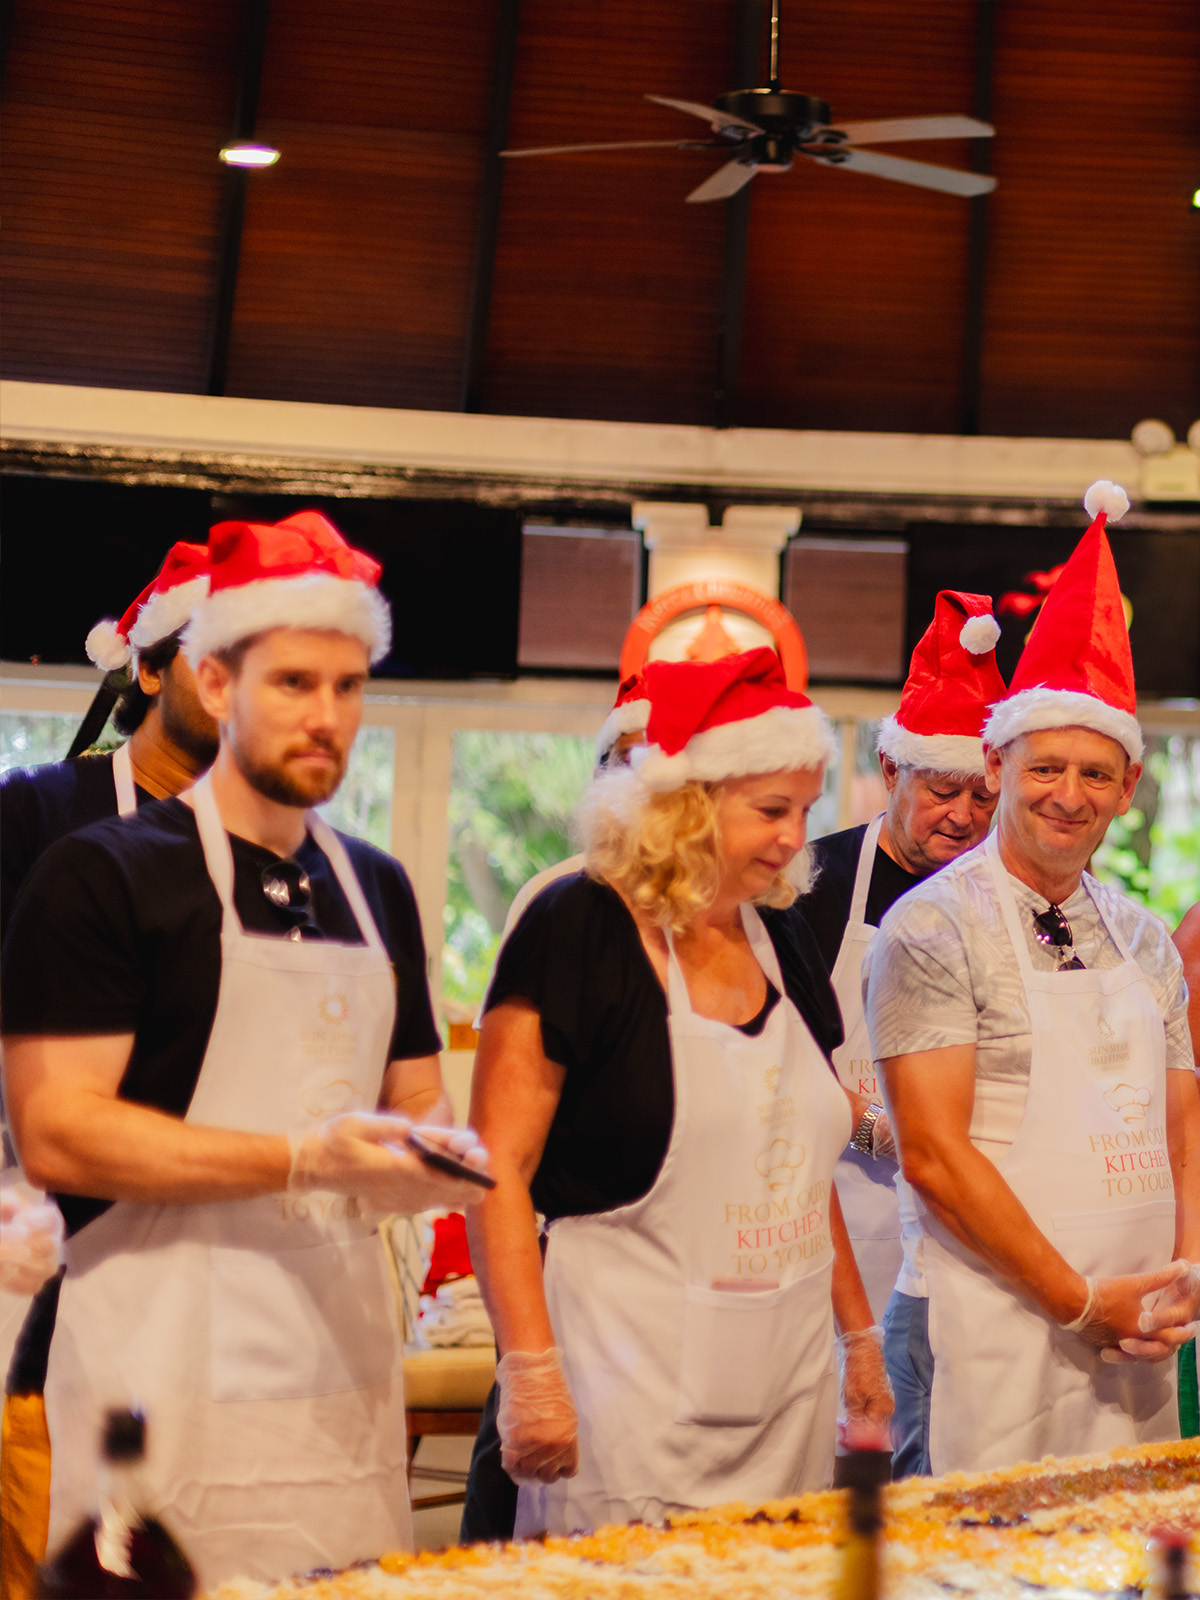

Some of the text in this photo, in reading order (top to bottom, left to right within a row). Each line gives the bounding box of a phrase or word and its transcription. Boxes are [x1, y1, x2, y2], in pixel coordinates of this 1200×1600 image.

[1088, 1129, 1146, 1153] FROM
[1102, 1176, 1133, 1197] TO
[275, 1198, 309, 1221] TO
[724, 1180, 828, 1225] FROM OUR
[736, 1209, 823, 1249] KITCHEN
[731, 1253, 767, 1275] TO
